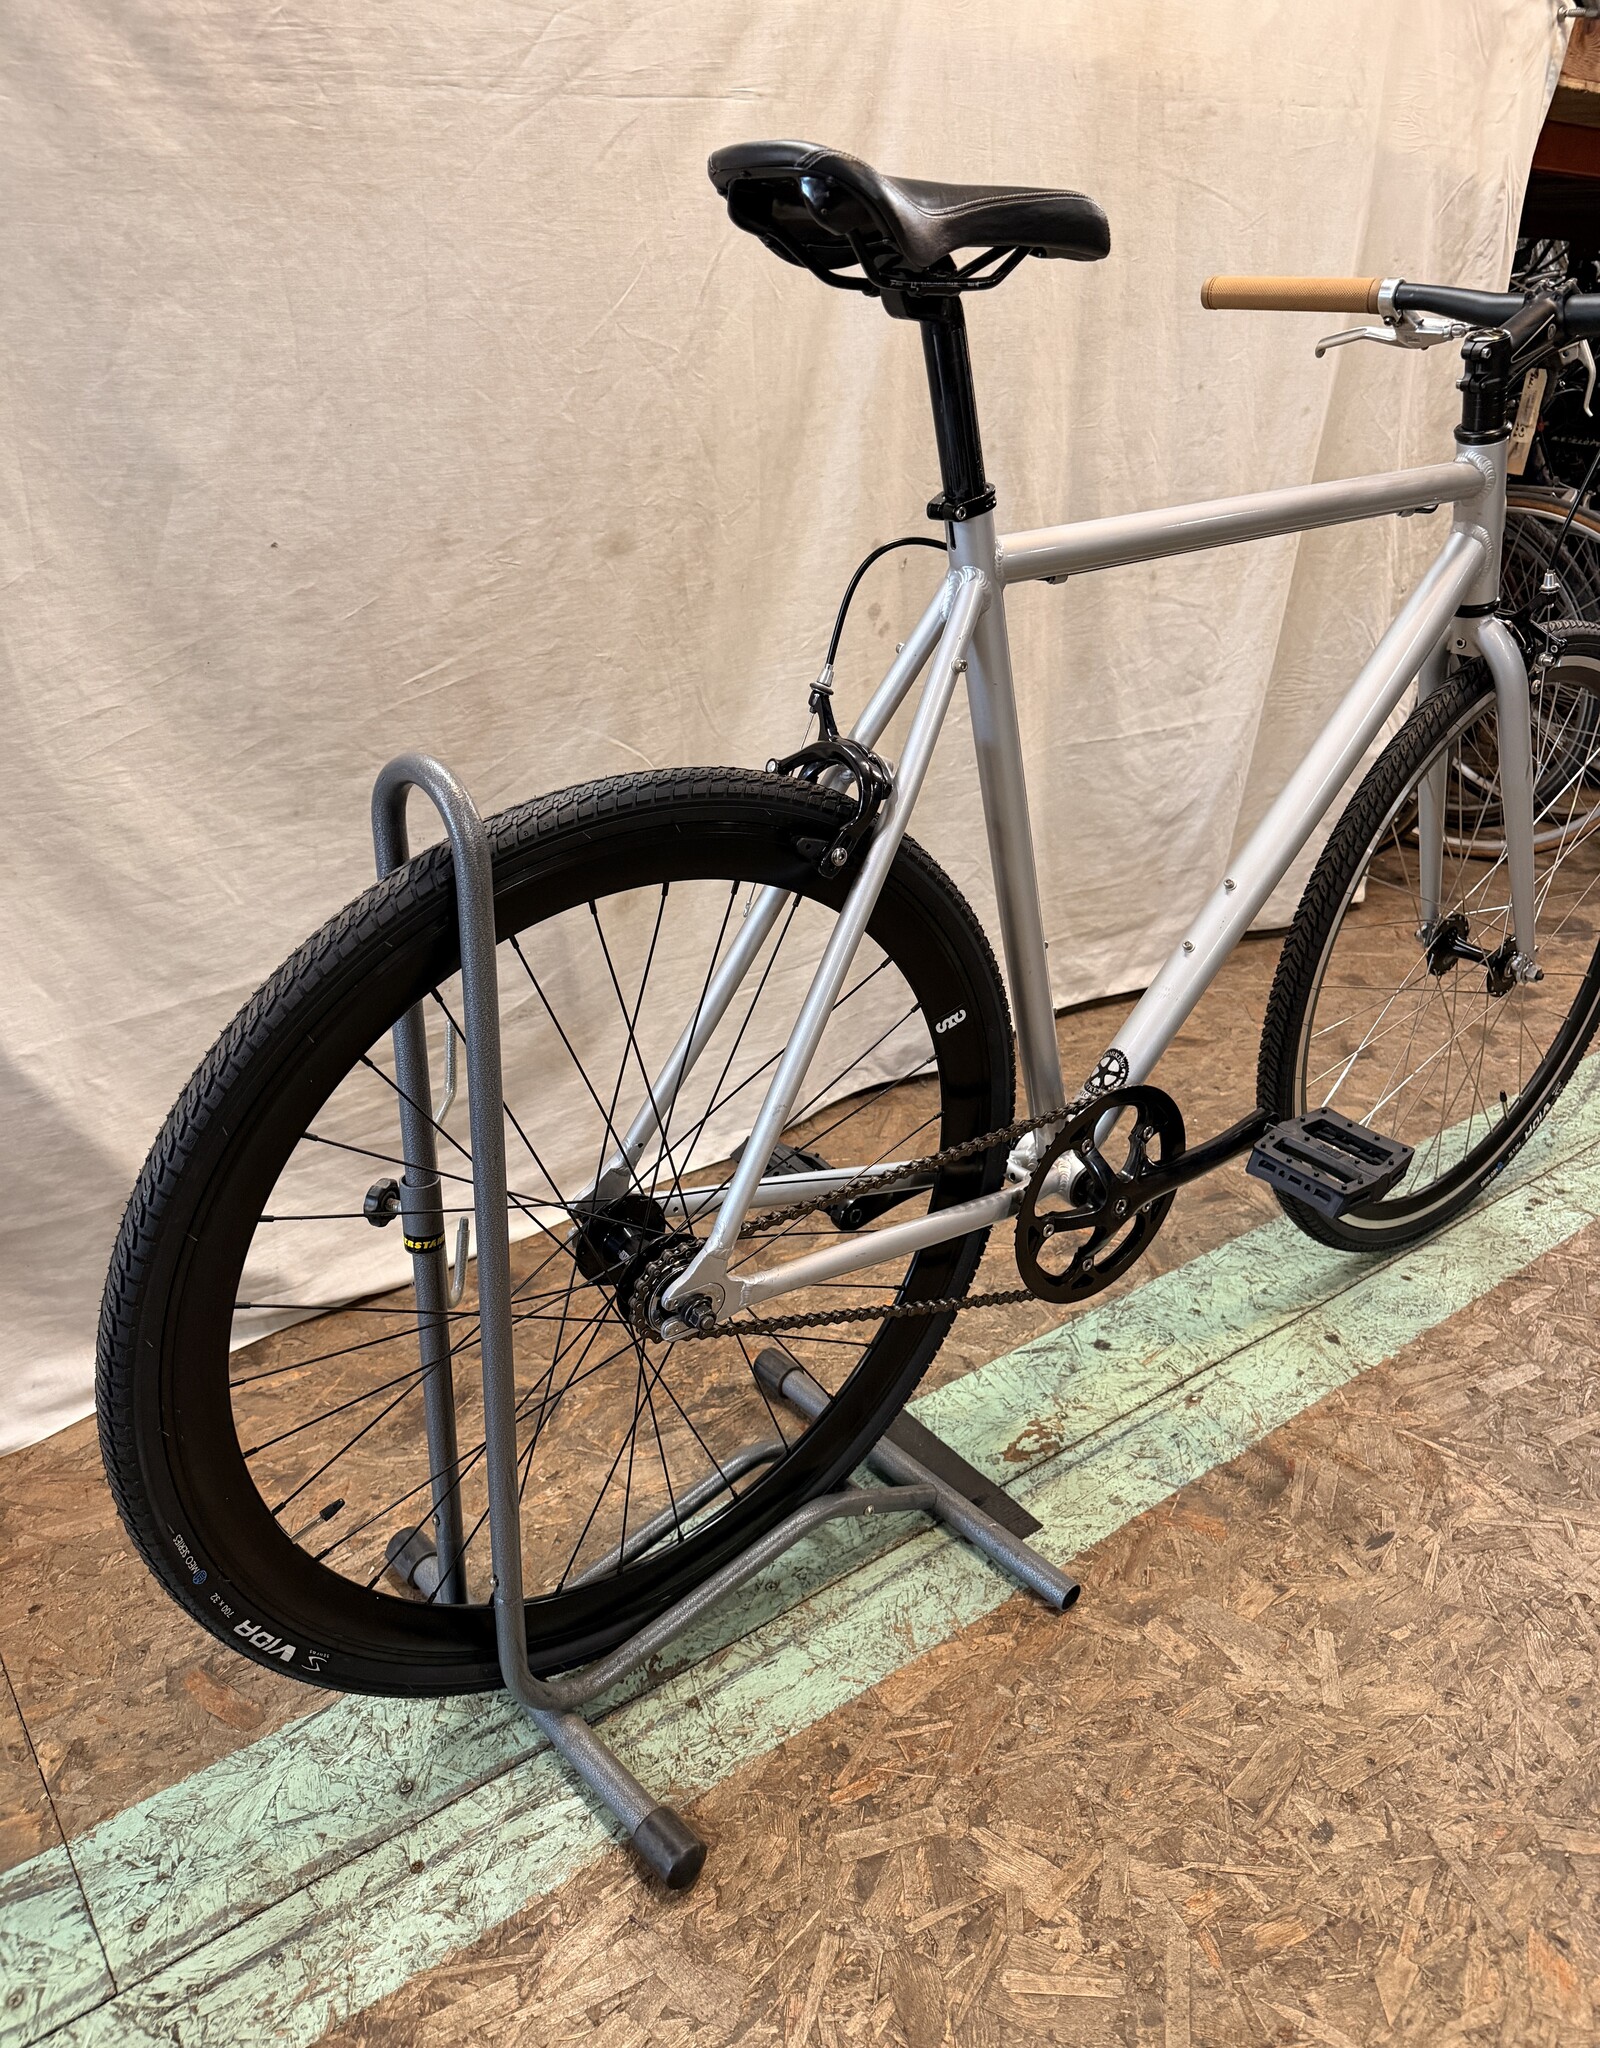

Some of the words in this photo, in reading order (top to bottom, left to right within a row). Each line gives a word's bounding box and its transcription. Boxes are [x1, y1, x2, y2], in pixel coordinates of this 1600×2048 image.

[172, 1533, 191, 1559] SERIES
[185, 1555, 200, 1575] MEO
[209, 1592, 221, 1604] 32
[220, 1604, 235, 1619] 700
[232, 1619, 297, 1663] VIDA
